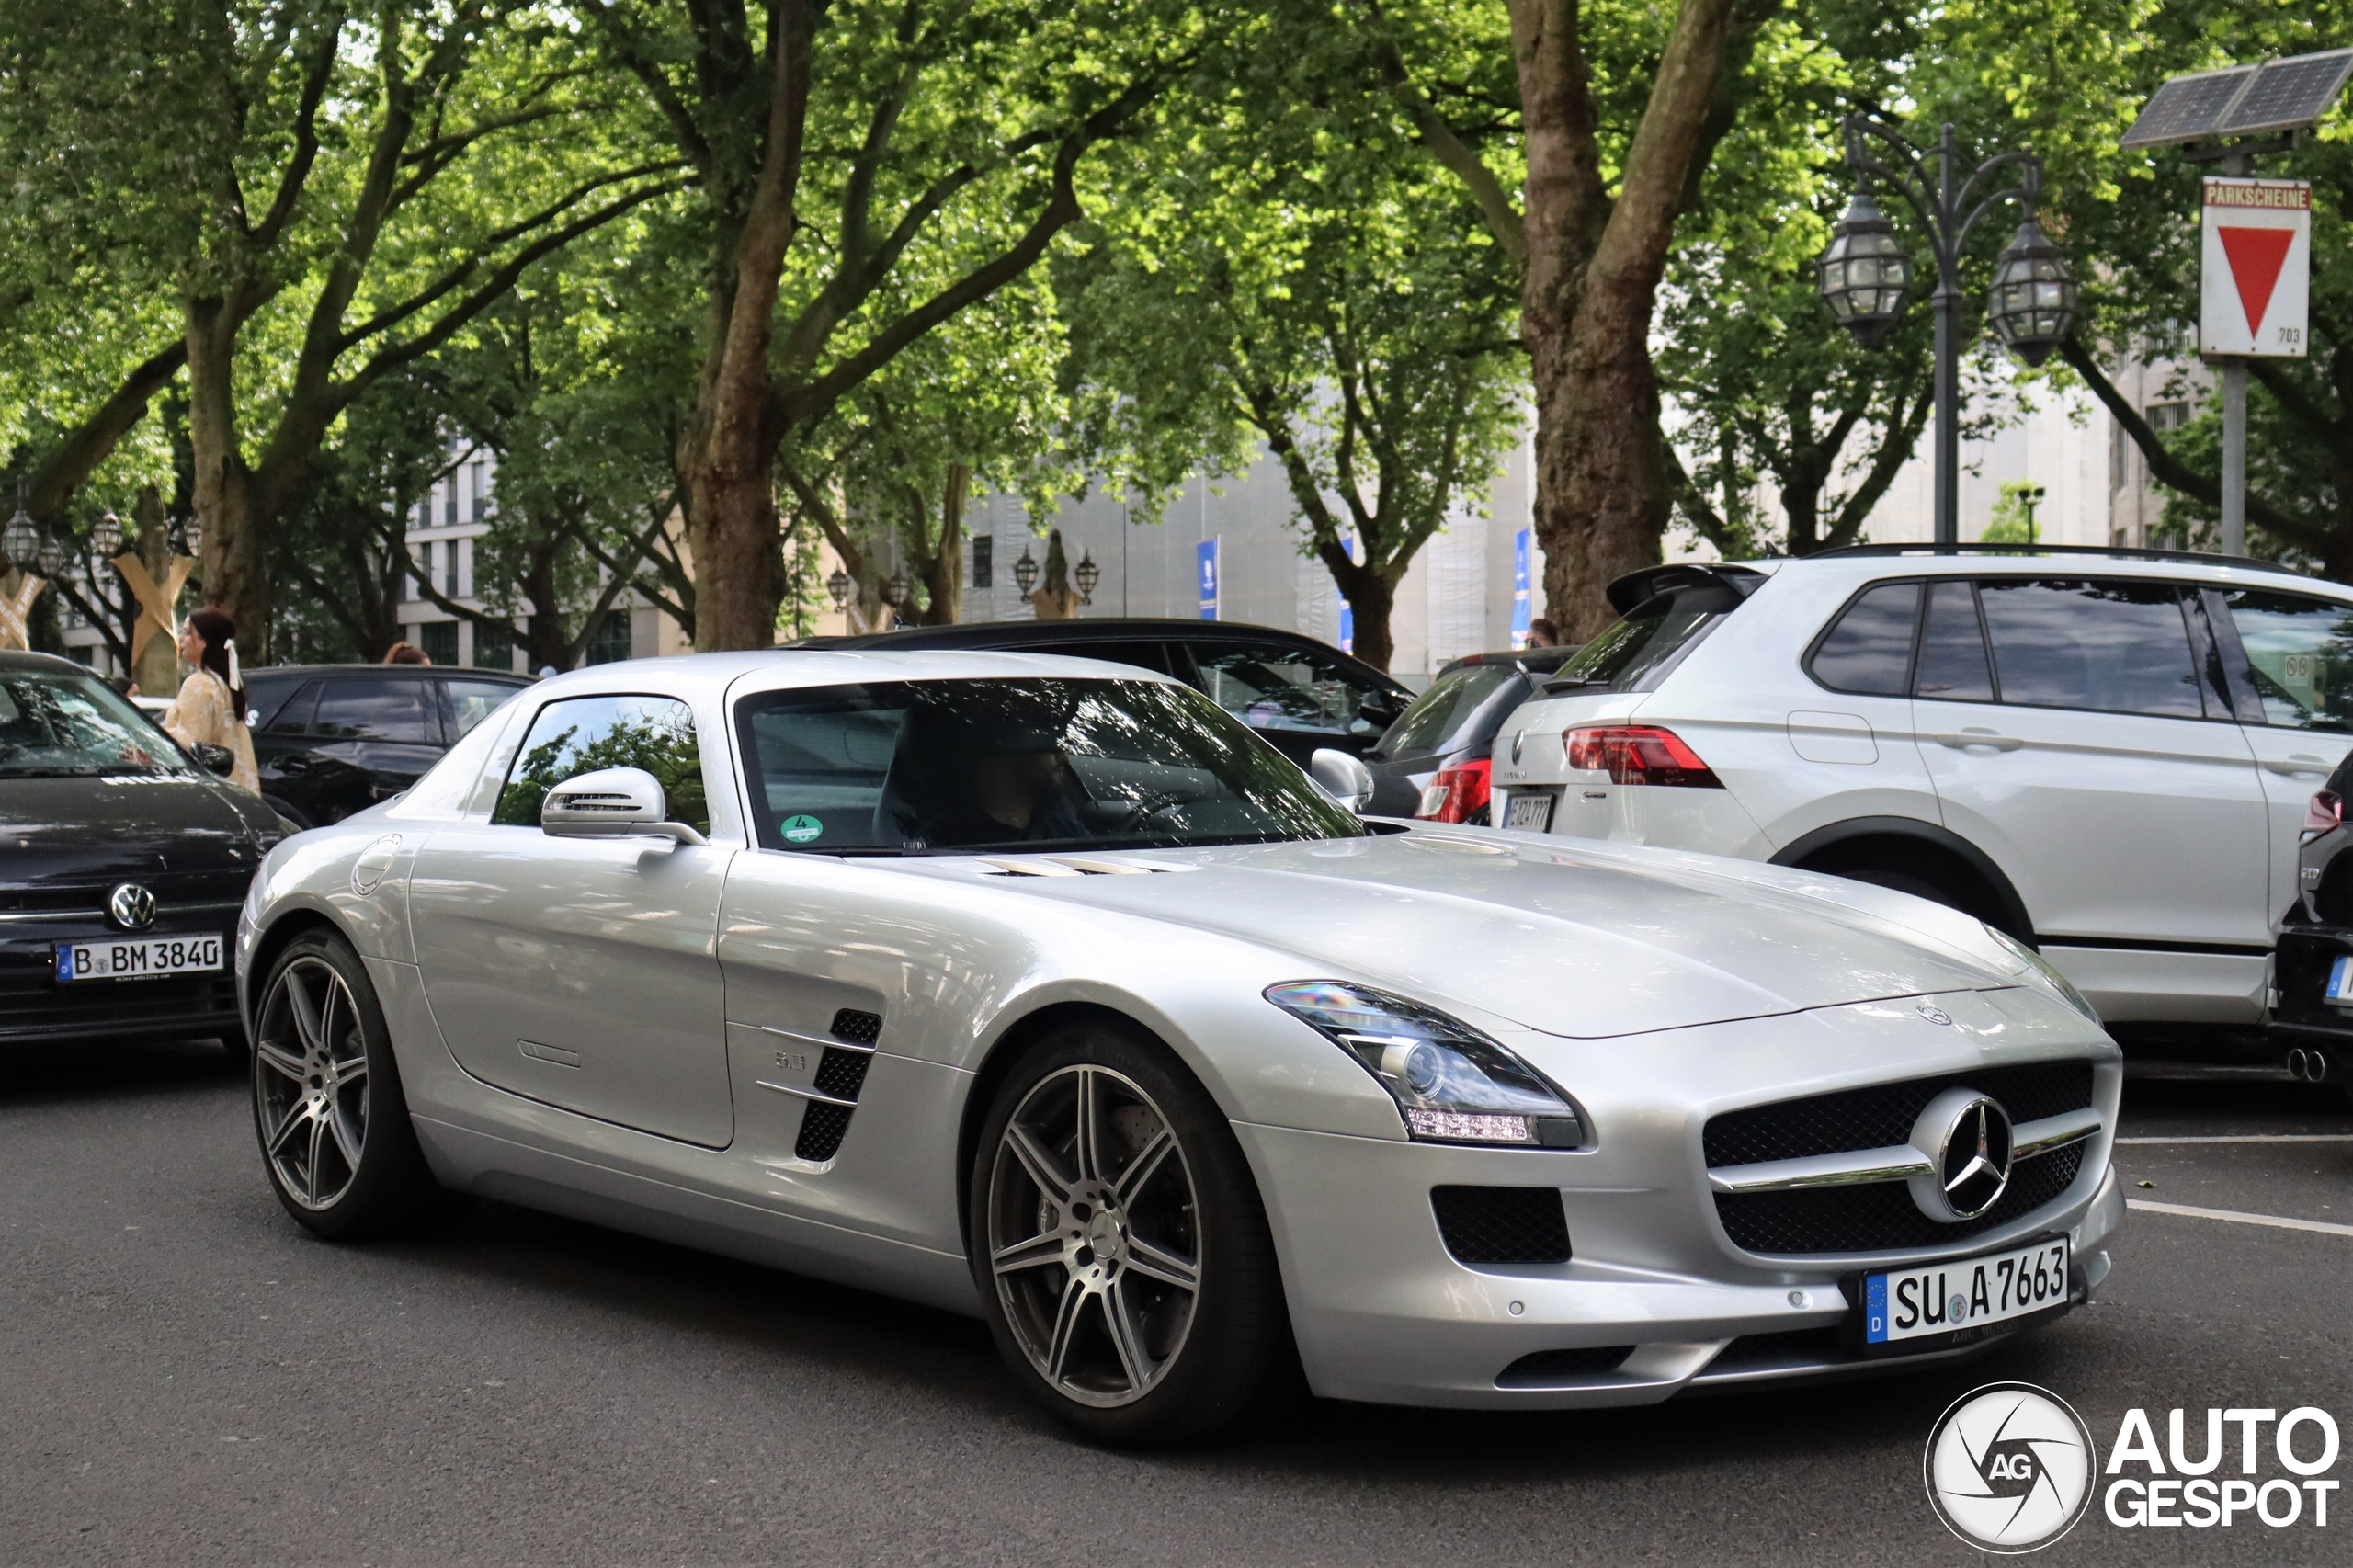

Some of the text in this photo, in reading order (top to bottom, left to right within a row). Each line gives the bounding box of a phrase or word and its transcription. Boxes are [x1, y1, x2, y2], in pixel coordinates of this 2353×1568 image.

[2206, 186, 2307, 208] PARKSCHEINE
[2279, 327, 2301, 343] 703
[795, 815, 808, 828] 4
[74, 948, 92, 975] B
[111, 944, 147, 972] BM
[153, 939, 218, 969] 3840
[1871, 1245, 2063, 1332] D SU A 7663
